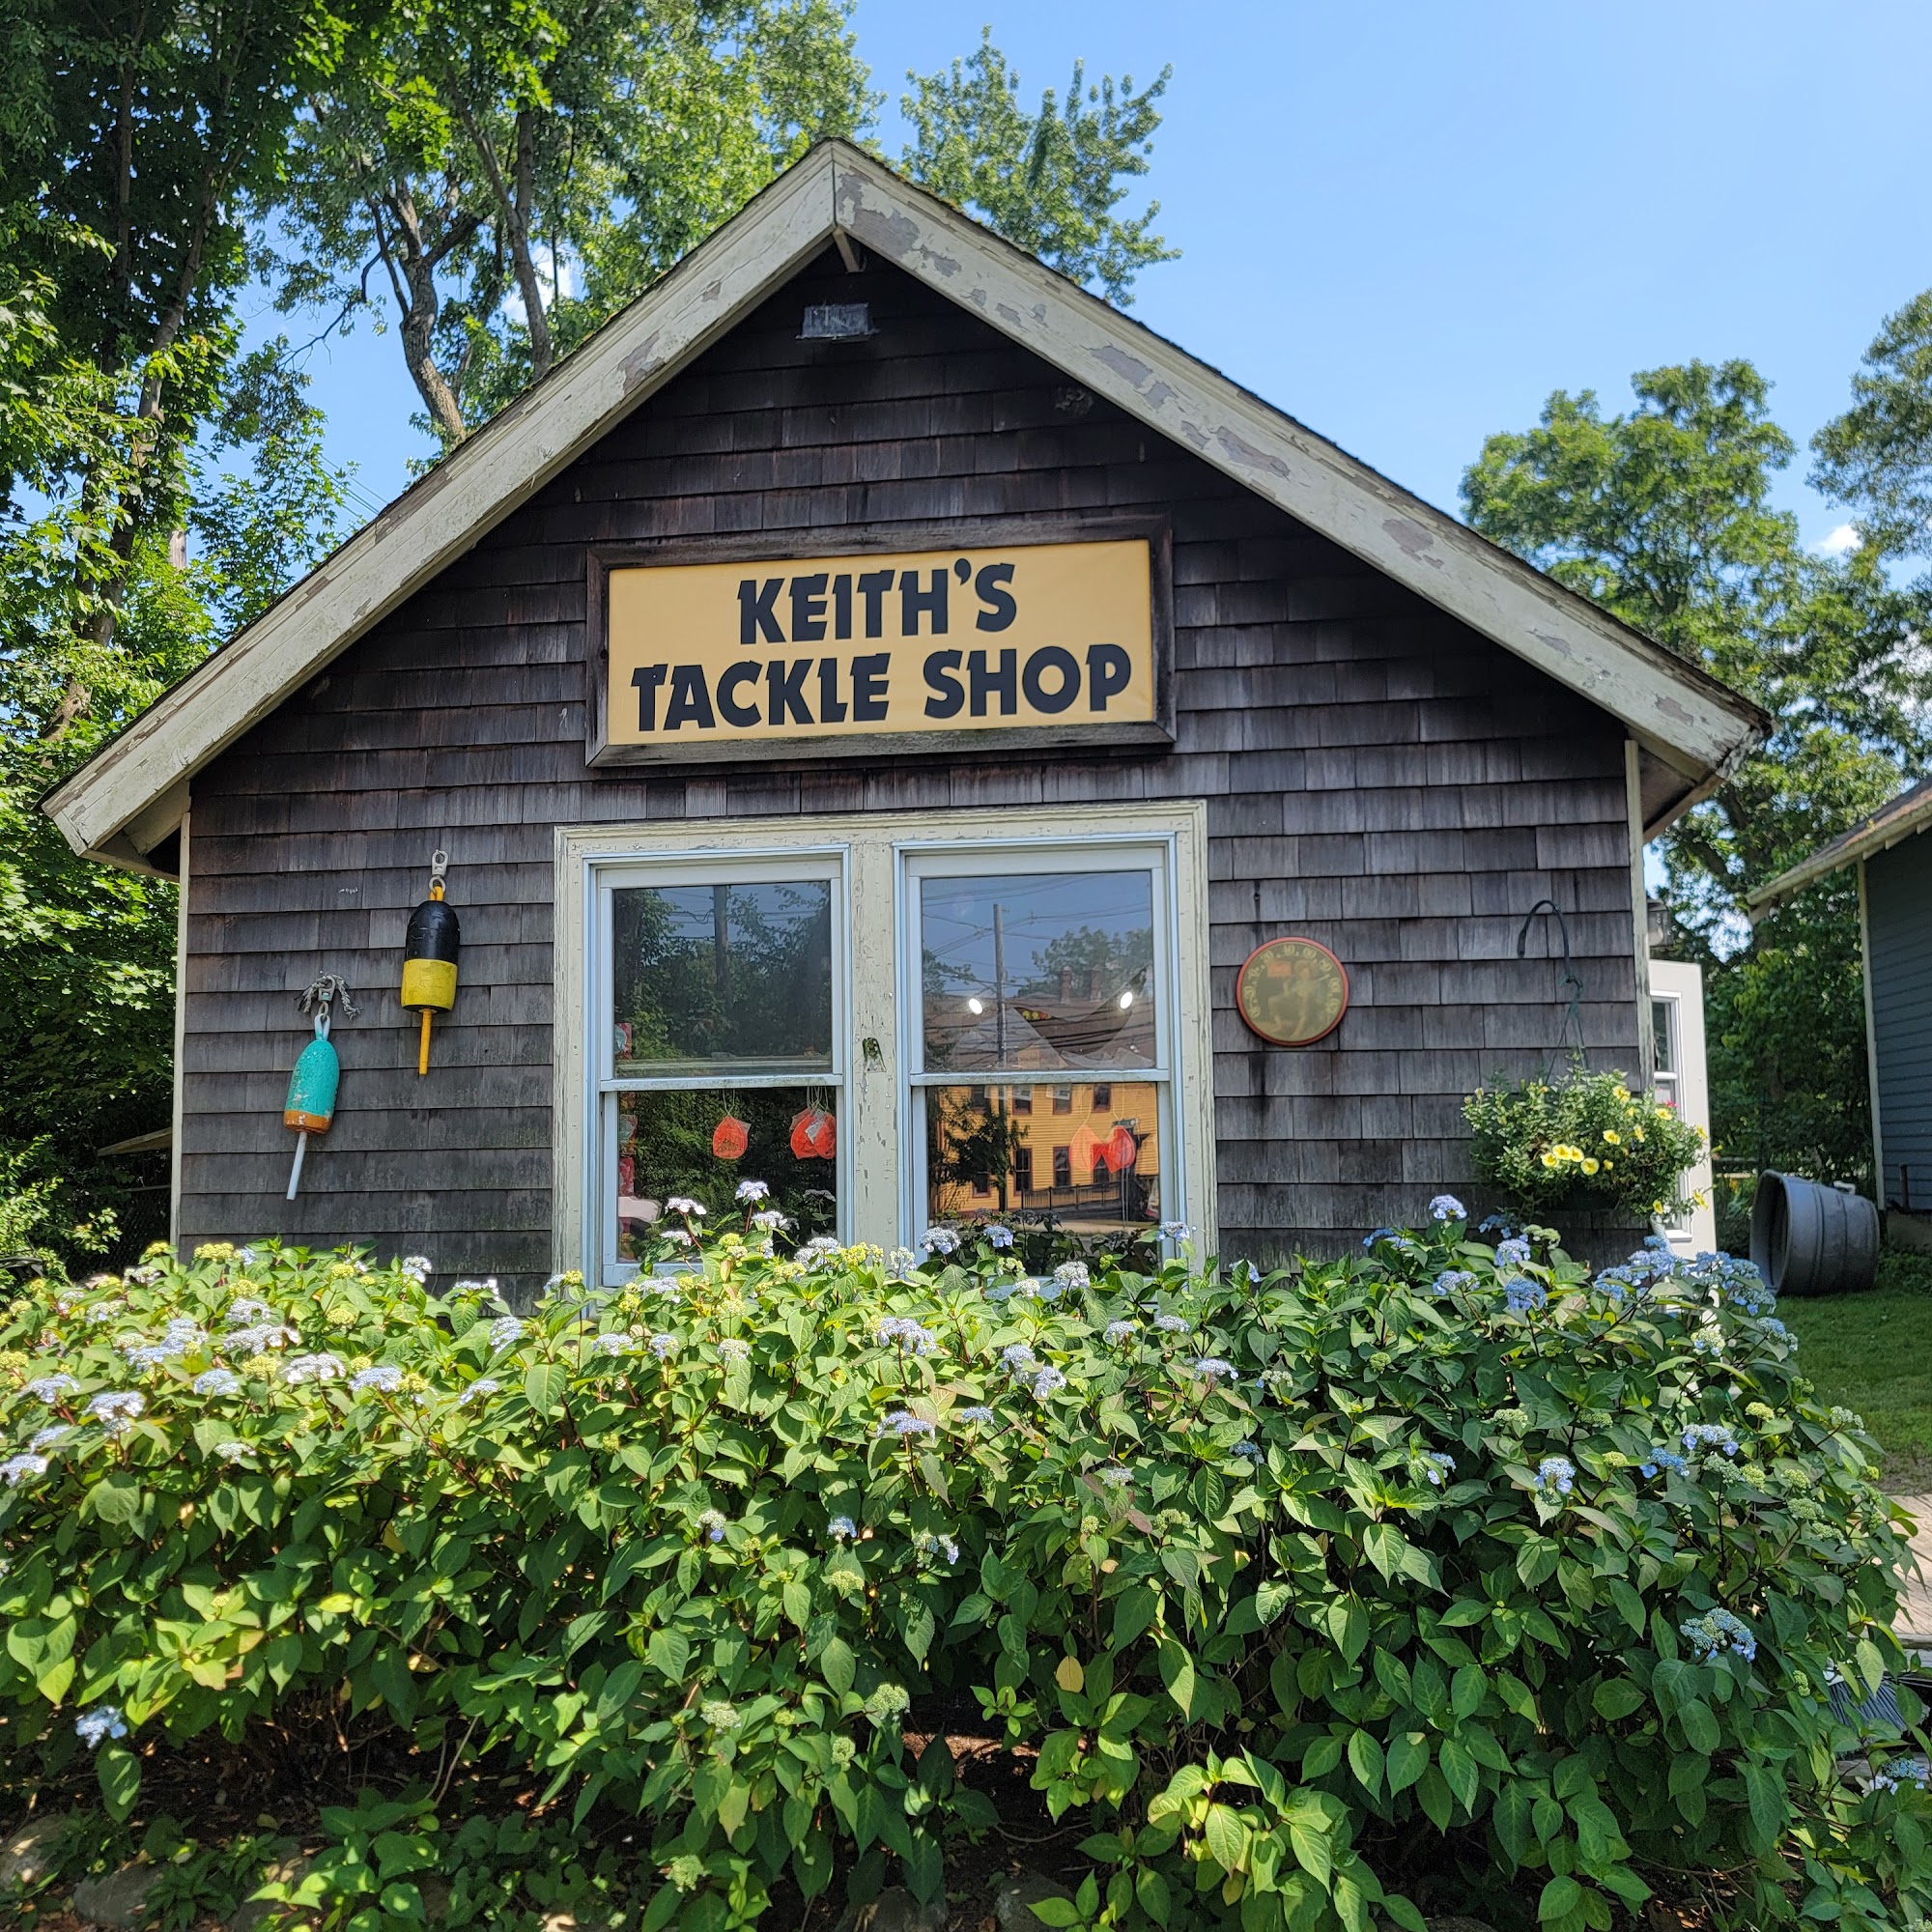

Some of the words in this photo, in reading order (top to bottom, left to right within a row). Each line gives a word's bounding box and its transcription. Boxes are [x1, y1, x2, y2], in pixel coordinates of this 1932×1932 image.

[737, 557, 1017, 645] KEITH'S
[630, 652, 892, 732] TACKLE
[923, 643, 1132, 720] SHOP
